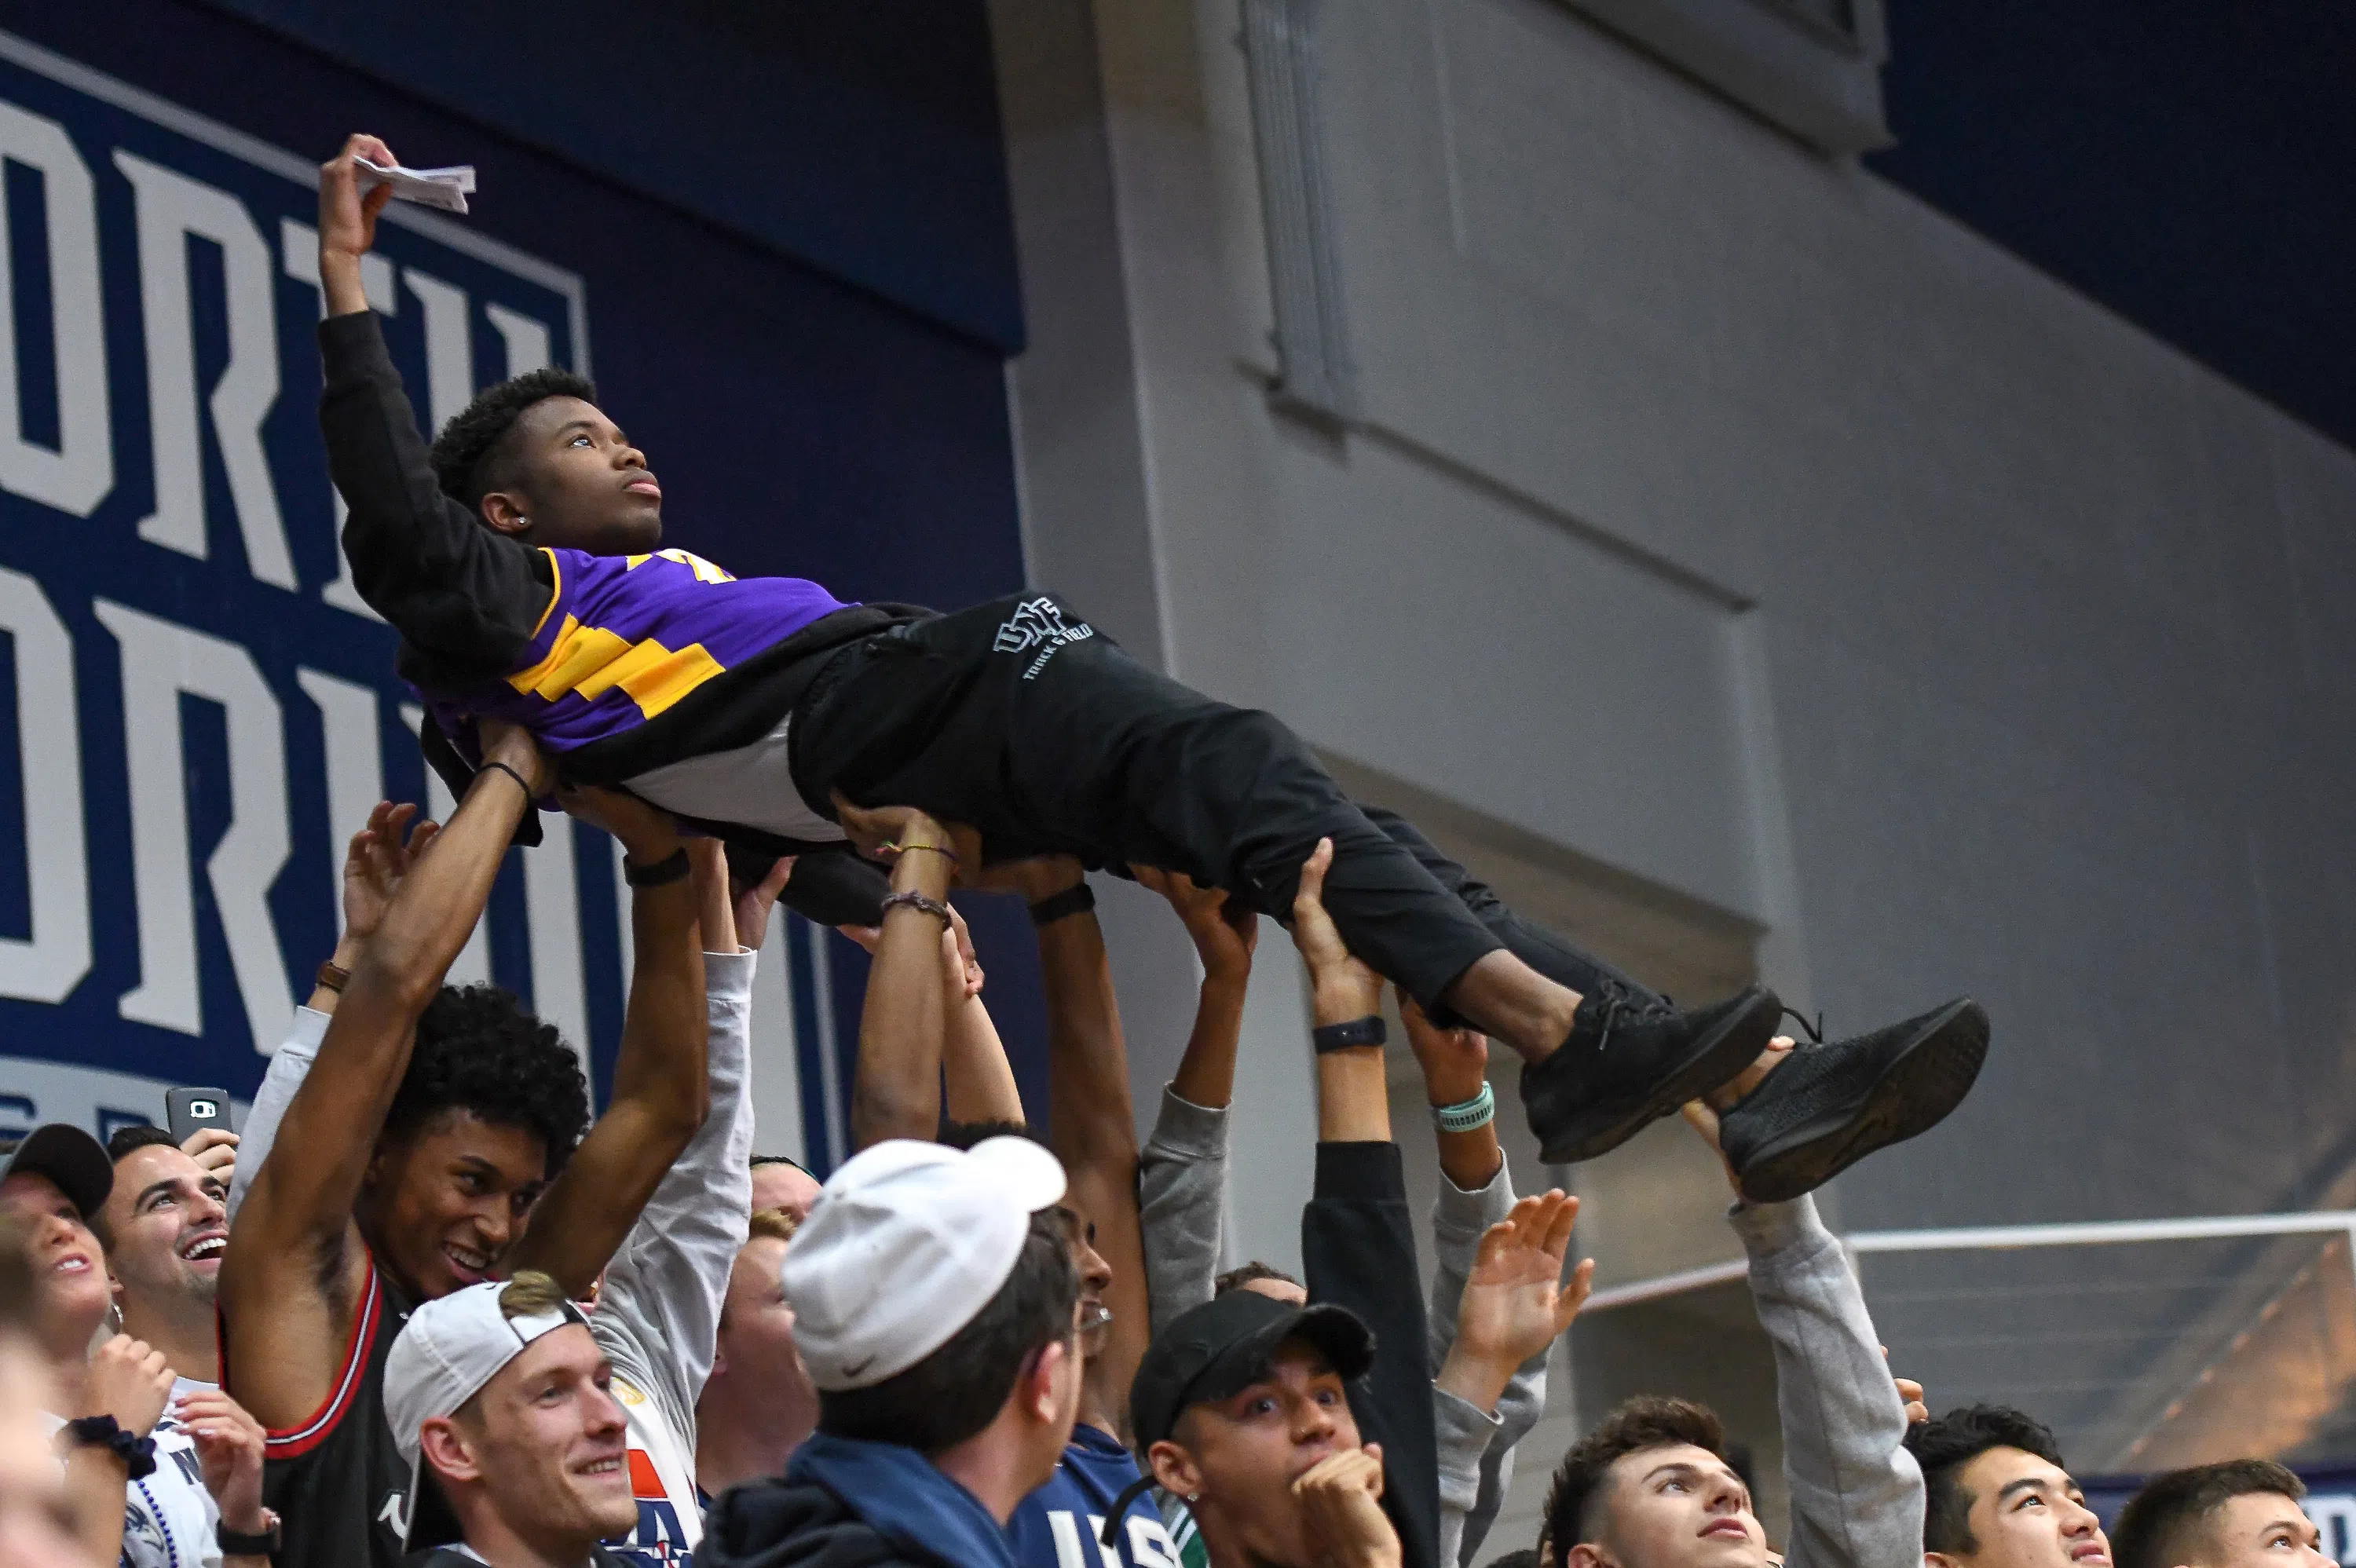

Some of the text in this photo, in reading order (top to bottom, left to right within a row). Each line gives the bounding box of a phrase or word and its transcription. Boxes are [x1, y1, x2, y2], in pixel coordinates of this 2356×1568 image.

[993, 597, 1066, 653] UNF
[1023, 645, 1057, 681] TRACK
[1062, 623, 1094, 642] FIELD
